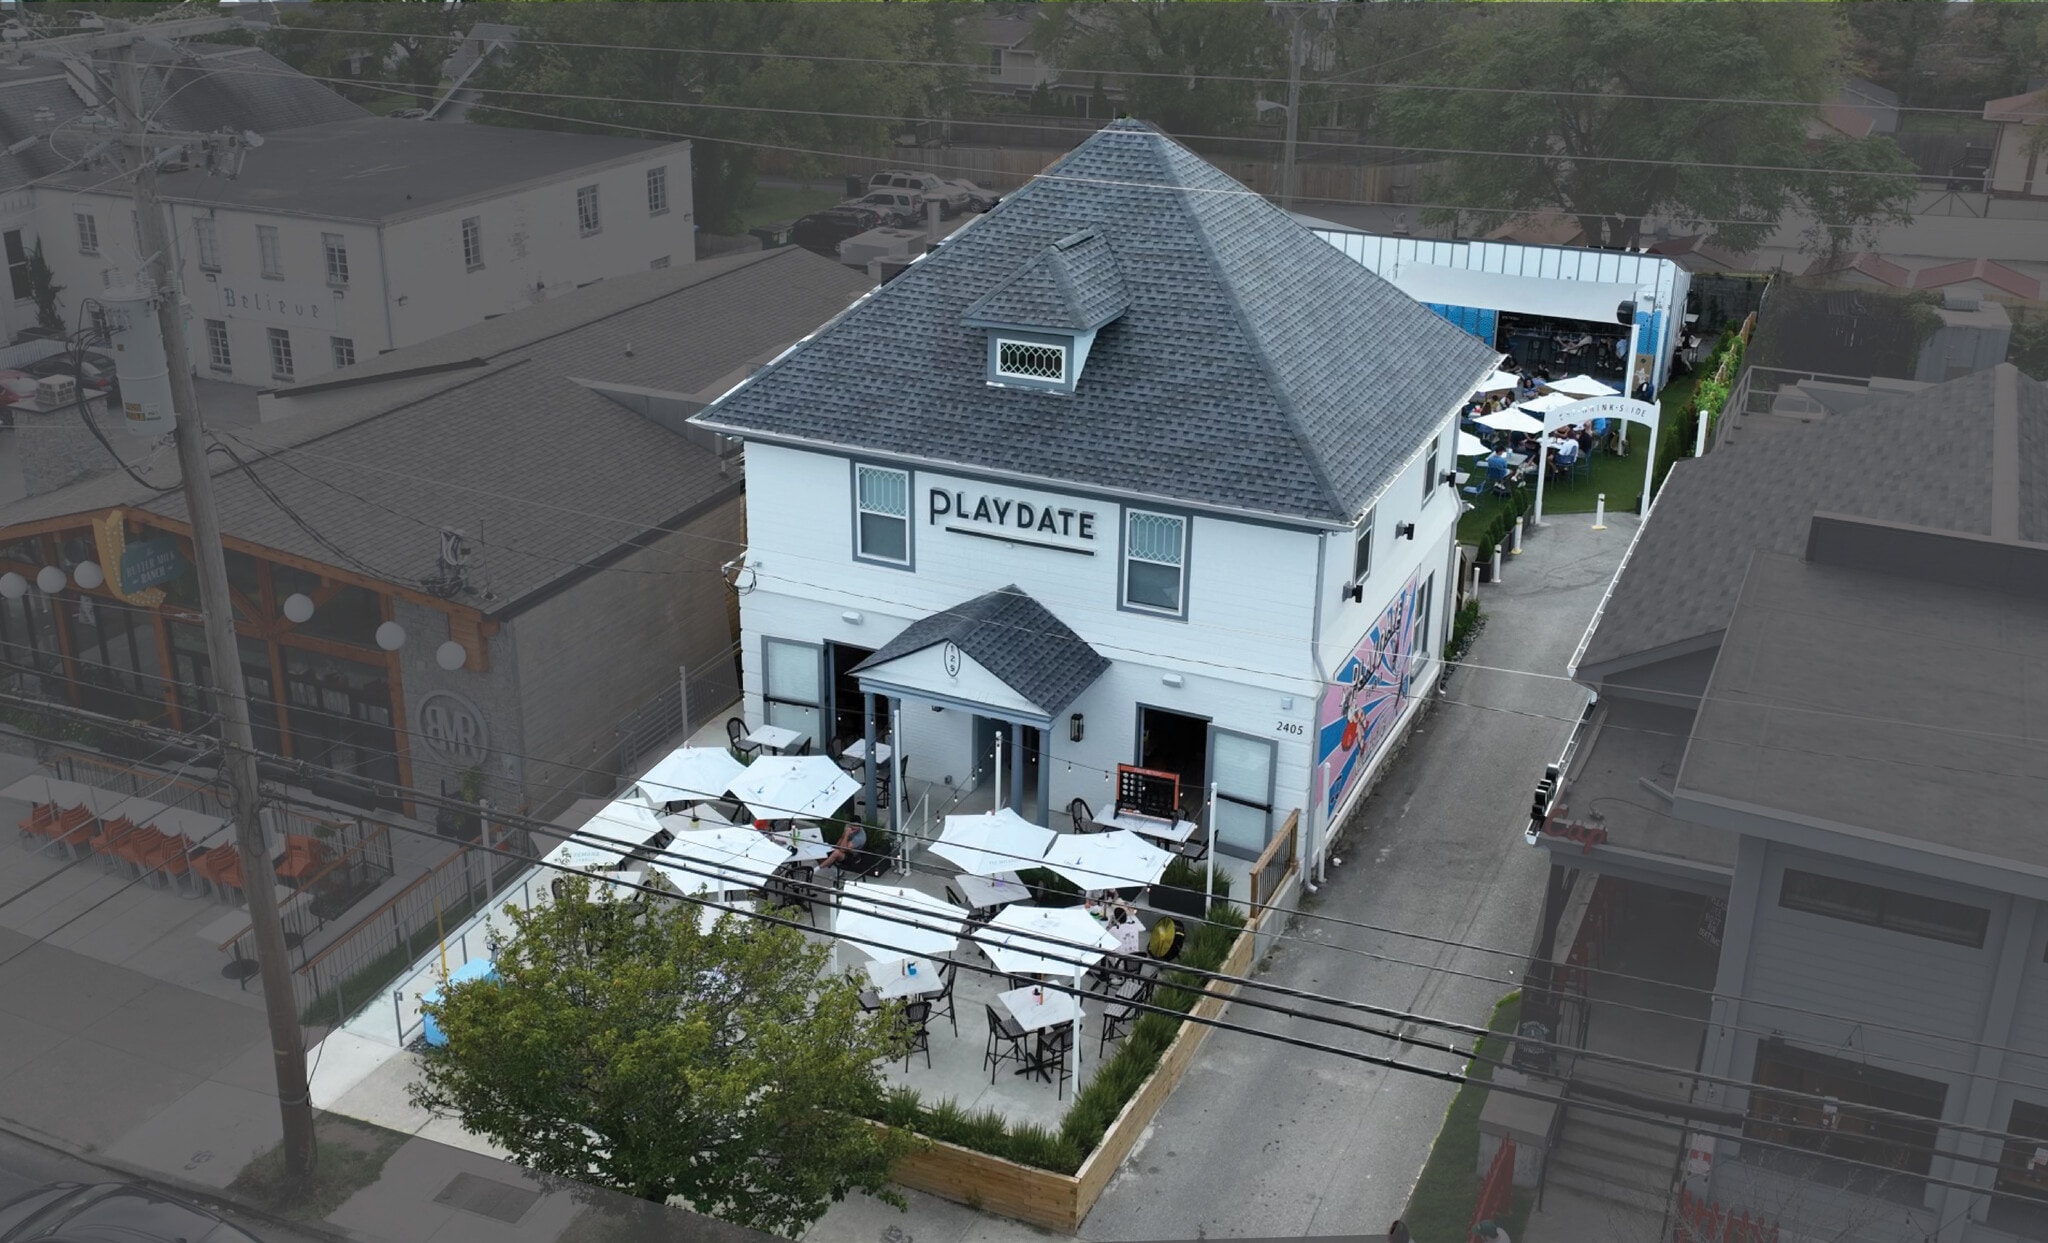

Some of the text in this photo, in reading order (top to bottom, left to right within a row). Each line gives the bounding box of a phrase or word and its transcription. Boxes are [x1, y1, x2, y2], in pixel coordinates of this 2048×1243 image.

[224, 287, 319, 319] Believe
[930, 487, 1097, 540] PLAYDATE
[1276, 720, 1304, 735] 2405
[1545, 807, 1607, 855] Cap
